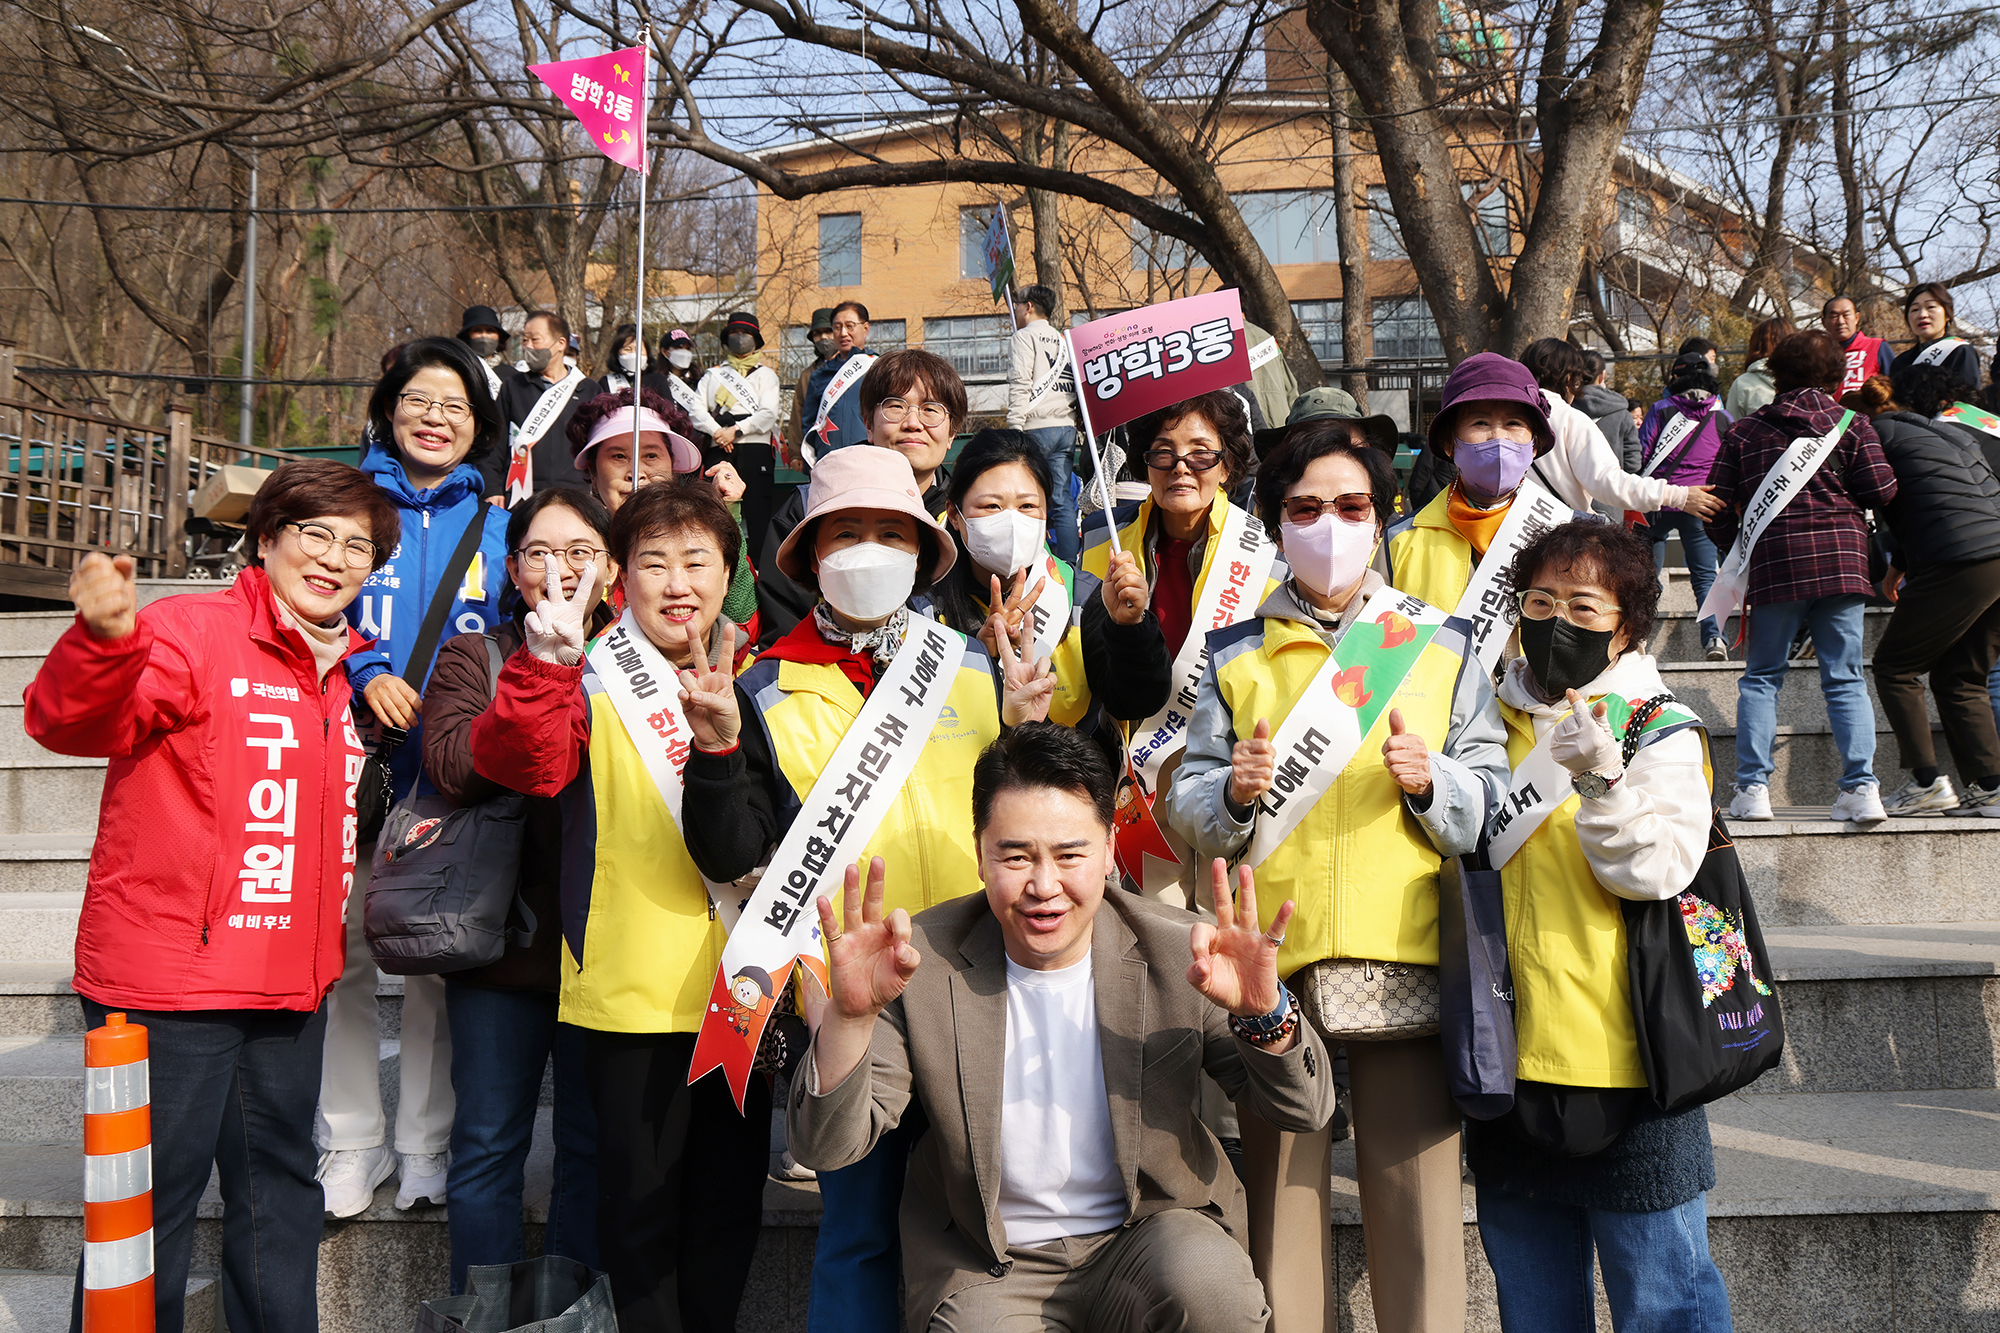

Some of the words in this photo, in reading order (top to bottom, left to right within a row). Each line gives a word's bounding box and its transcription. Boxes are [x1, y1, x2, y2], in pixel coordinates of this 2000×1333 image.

[570, 72, 634, 122] 방학3동
[1083, 316, 1236, 401] 방학3동
[1842, 350, 1868, 394] 강신
[252, 682, 300, 702] 국민의힘
[899, 627, 948, 708] 도봉구
[646, 707, 690, 786] 한순
[1132, 709, 1188, 769] 한평생
[1258, 726, 1332, 819] 도봉구
[238, 712, 300, 904] 구의원
[763, 711, 910, 939] 주민자치협의회
[1486, 781, 1544, 846] 도봉
[227, 914, 291, 930] 예비후보
